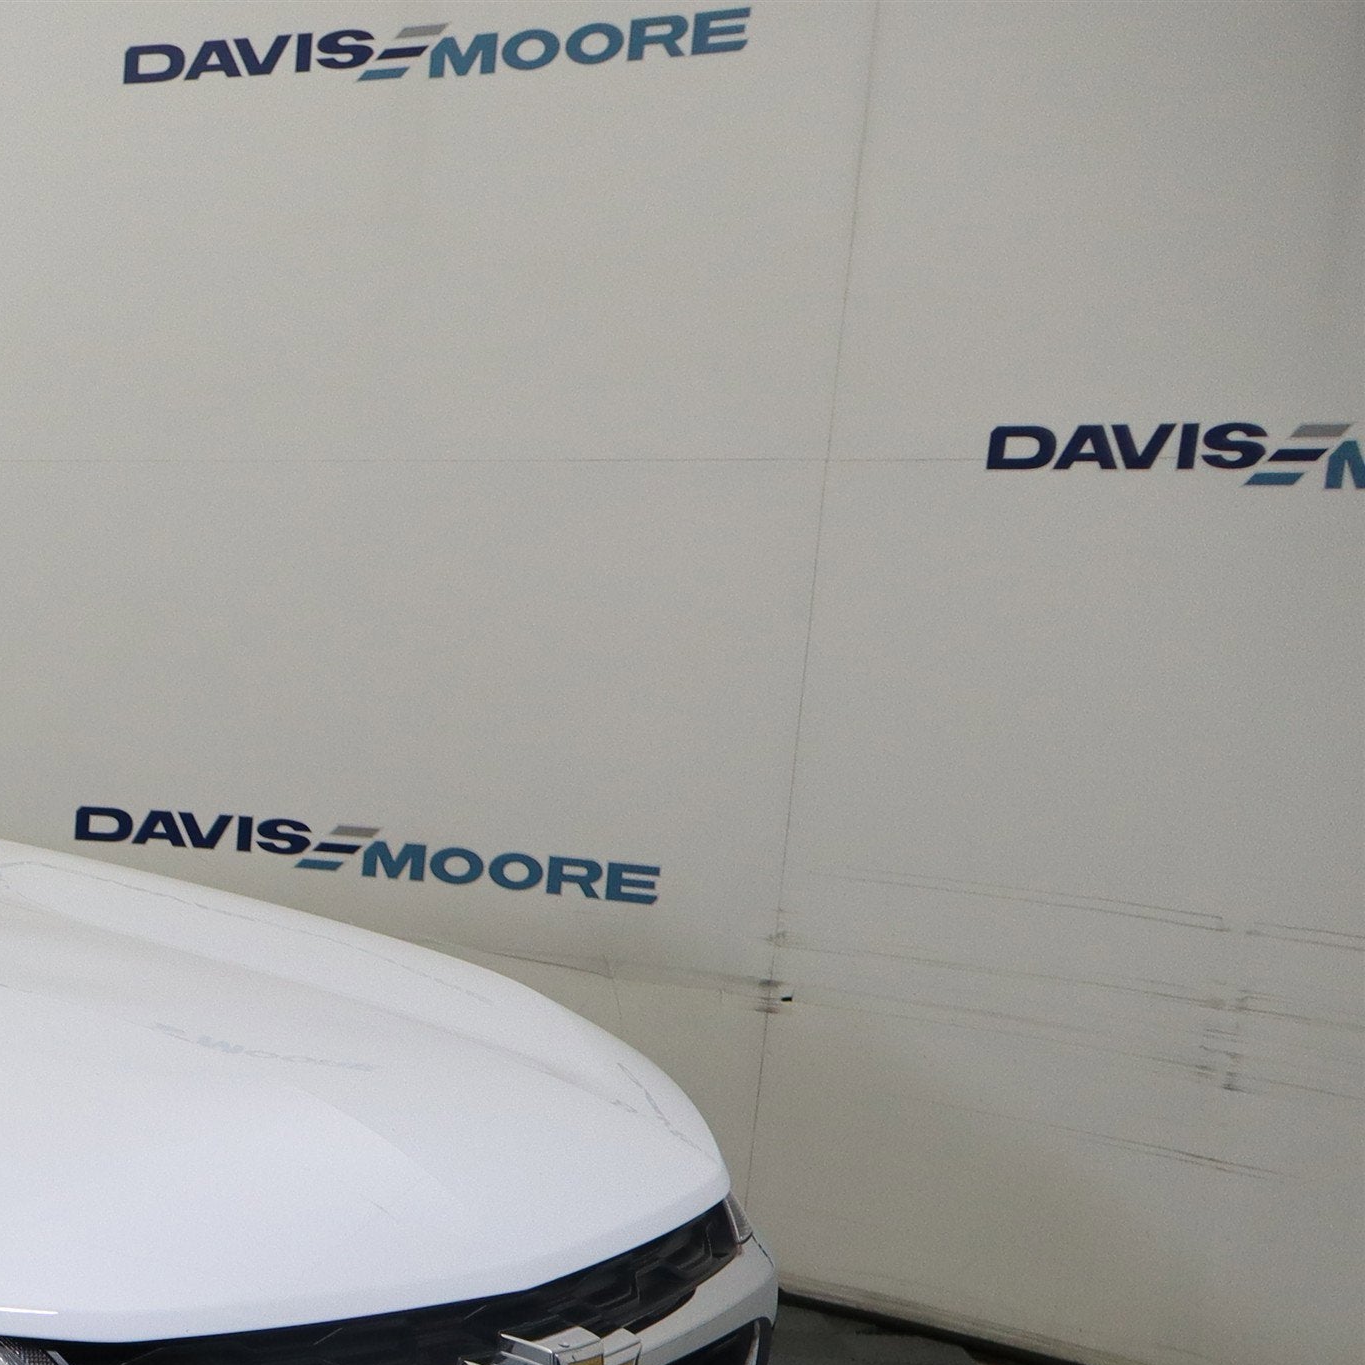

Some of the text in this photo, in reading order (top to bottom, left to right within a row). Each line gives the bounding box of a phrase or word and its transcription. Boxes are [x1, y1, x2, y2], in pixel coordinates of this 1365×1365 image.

[122, 6, 752, 84] DAVIS MOORE
[986, 421, 1267, 469] DAVIS
[74, 805, 662, 906] DAVIS MOORE
